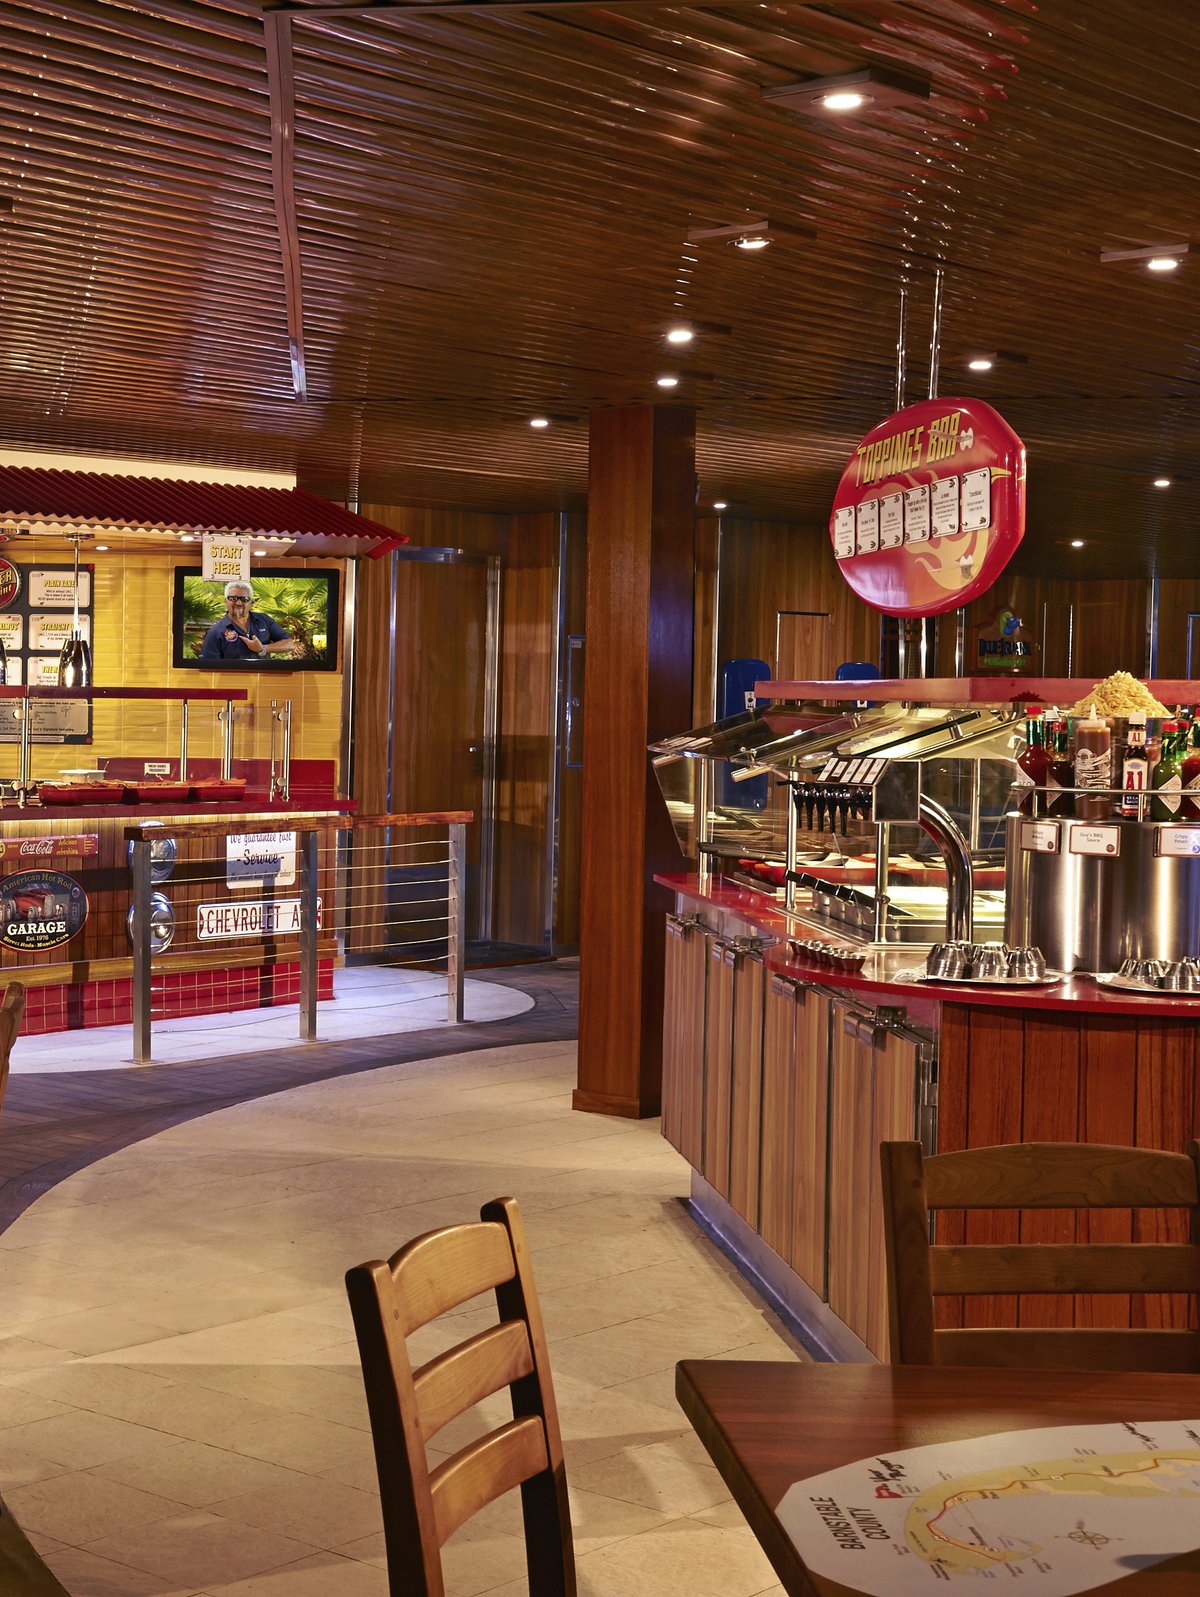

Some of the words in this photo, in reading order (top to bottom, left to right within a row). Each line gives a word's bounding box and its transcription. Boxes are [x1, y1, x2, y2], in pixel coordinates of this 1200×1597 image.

[856, 426, 924, 488] TOPPINGS
[926, 411, 961, 464] BAR
[210, 546, 243, 559] START
[213, 562, 241, 575] HERE
[20, 840, 54, 856] Coca-Cola
[243, 849, 278, 865] Service
[3, 874, 40, 892] American
[41, 873, 57, 881] Hot
[57, 876, 73, 890] Rod
[207, 905, 281, 934] CHEVROLET
[7, 921, 66, 936] GARAGE
[810, 1497, 866, 1549] BARNSTABLE
[847, 1507, 890, 1540] COUNTY
